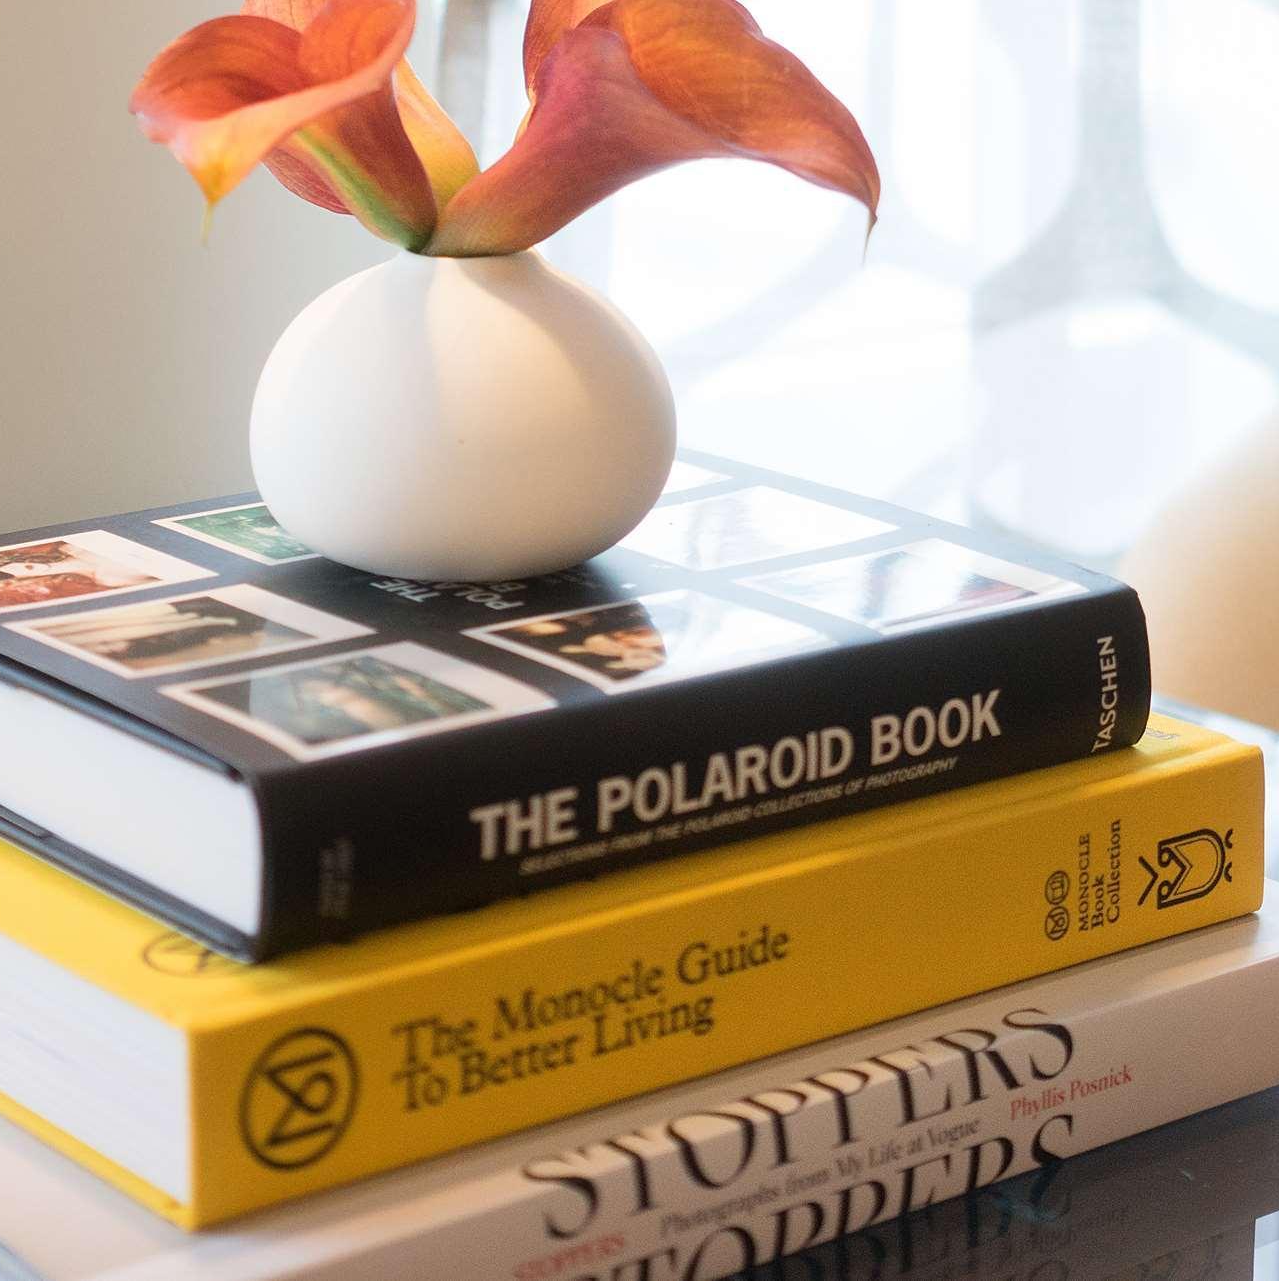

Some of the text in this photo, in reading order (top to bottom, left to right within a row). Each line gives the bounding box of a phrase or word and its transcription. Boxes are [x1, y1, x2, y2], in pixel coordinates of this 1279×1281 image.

[1091, 635, 1118, 753] TASCHEN
[470, 688, 1001, 861] THE POLAROID BOOK
[866, 756, 959, 792] PHOTOGRAPHY
[1079, 832, 1090, 932] MONOCLE
[1091, 874, 1105, 930] Book
[1106, 819, 1120, 923] Collection
[391, 924, 790, 1069] The Monocle Guide
[391, 994, 716, 1113] To Better Living
[1009, 1065, 1133, 1121] Phyllis Posnick
[523, 1007, 1074, 1239] STOPPERS
[836, 1153, 863, 1181] My
[869, 1137, 901, 1166] Life
[926, 1119, 979, 1149] Vogue
